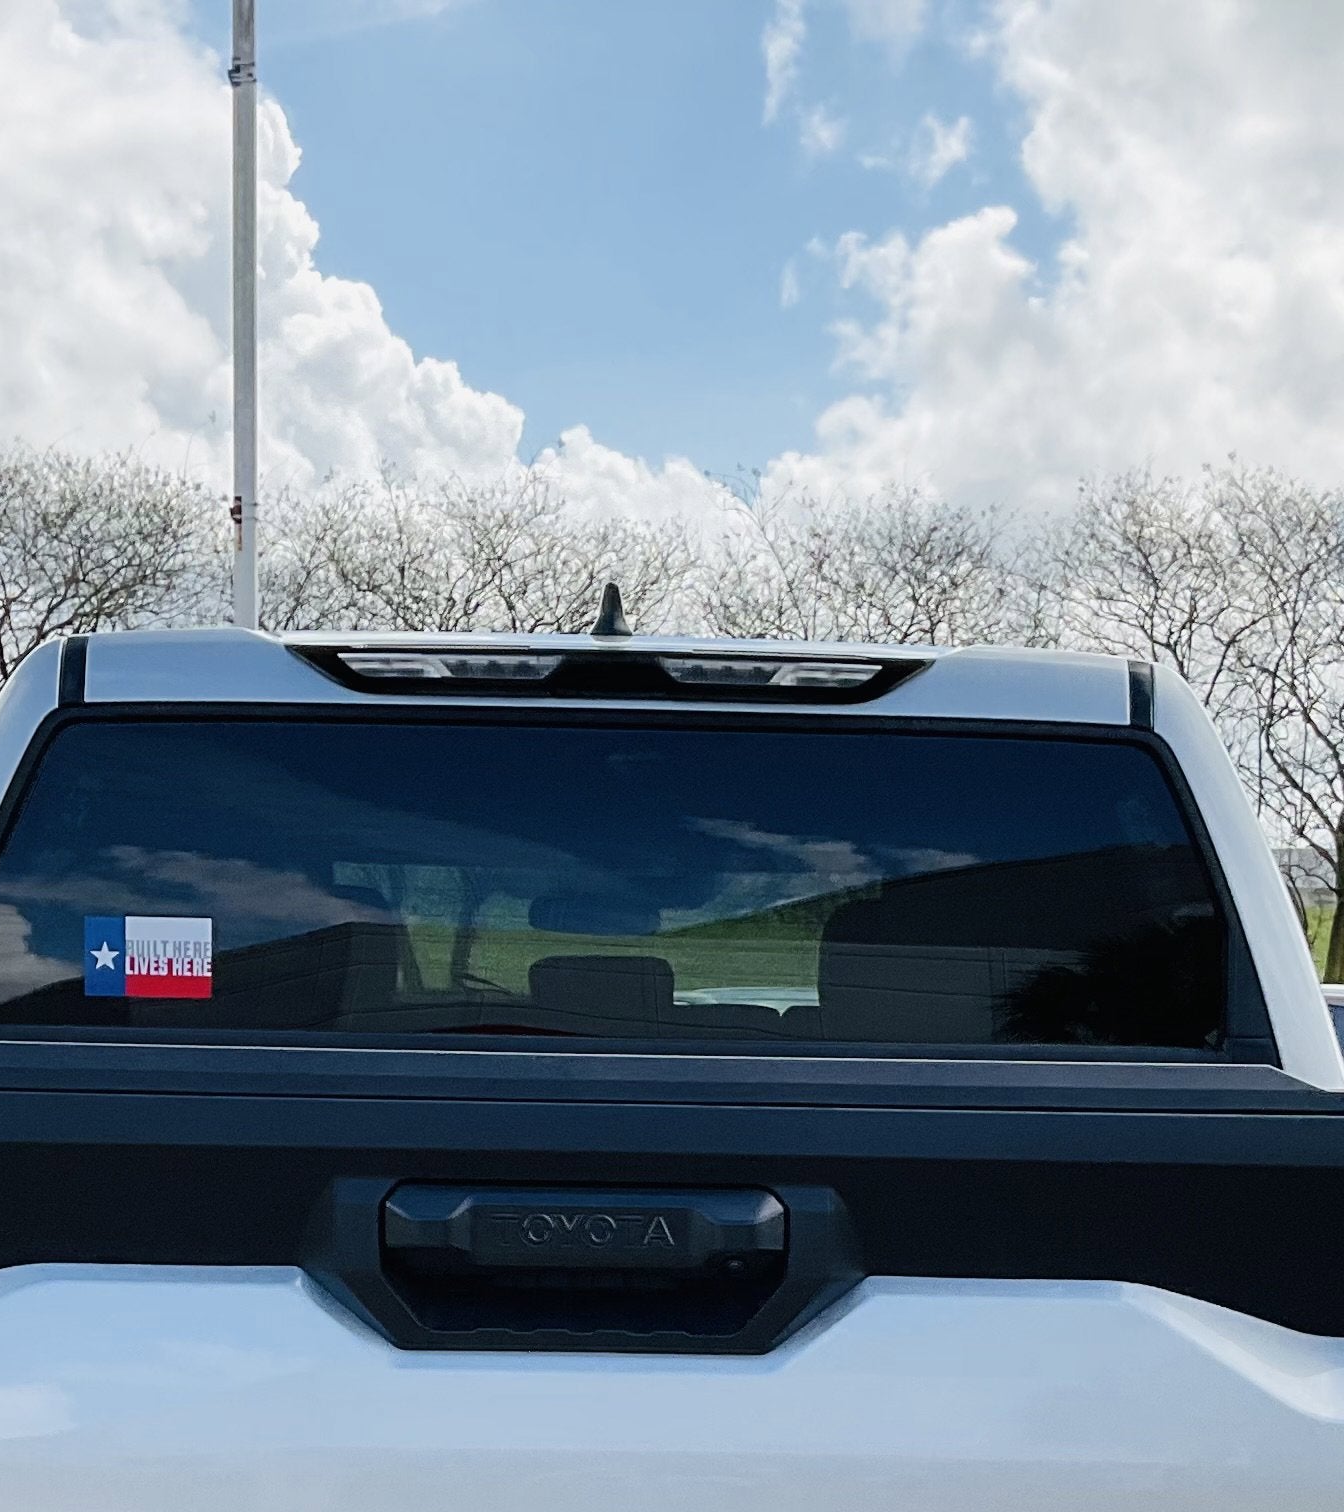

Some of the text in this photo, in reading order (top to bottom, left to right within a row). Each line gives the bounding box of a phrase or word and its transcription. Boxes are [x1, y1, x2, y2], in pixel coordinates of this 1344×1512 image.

[126, 940, 212, 959] BUILT HERE
[125, 957, 213, 976] LIVES HERE
[490, 1213, 675, 1248] TOYOTA
